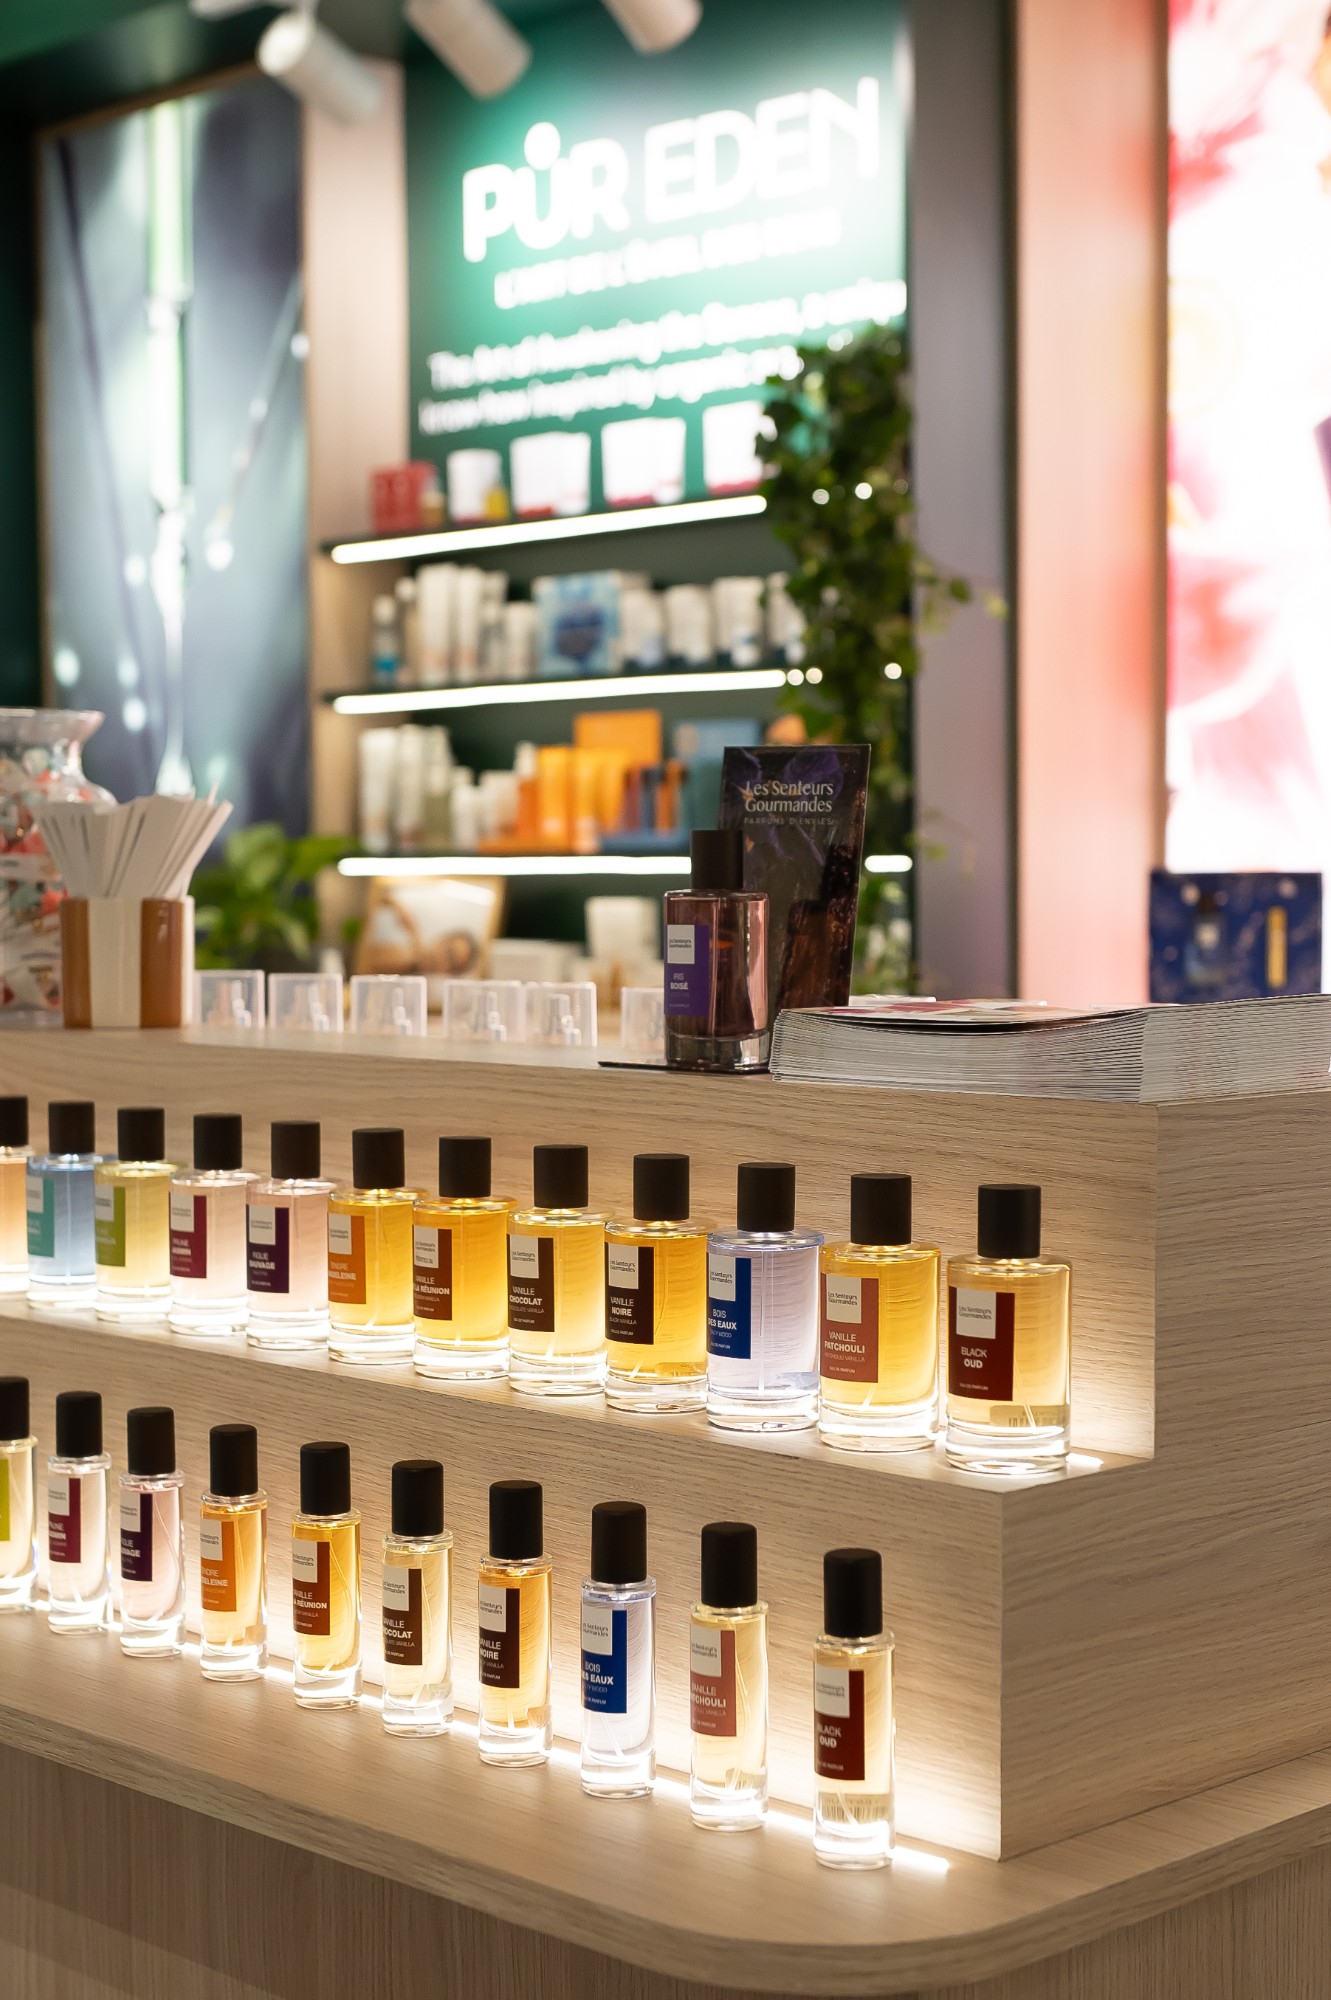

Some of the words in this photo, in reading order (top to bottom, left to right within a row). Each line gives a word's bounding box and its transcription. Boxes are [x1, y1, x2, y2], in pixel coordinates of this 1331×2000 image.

[644, 76, 879, 223] EDEN
[745, 781, 769, 796] Les
[771, 780, 834, 796] Senteurs
[745, 796, 833, 813] Gourmandes
[420, 1286, 449, 1294] RÉUNION
[512, 1286, 534, 1296] VANILLE
[509, 1295, 542, 1306] CHOCOLAT
[610, 1296, 633, 1306] VANILLE
[828, 1297, 857, 1306] Gourmandes
[611, 1307, 632, 1316] NOIRE
[713, 1308, 726, 1318] BOIS
[717, 1320, 736, 1330] EAUX
[828, 1331, 856, 1342] VANILLE
[824, 1341, 864, 1354] PATCHOULI
[960, 1346, 987, 1358] BLACK
[845, 1354, 864, 1362] VANILLA
[963, 1359, 982, 1368] OUD
[298, 1600, 326, 1610] RÉUNION
[585, 1661, 600, 1674] BOIS
[590, 1674, 613, 1686] EAUX
[819, 1736, 837, 1748] OUD
